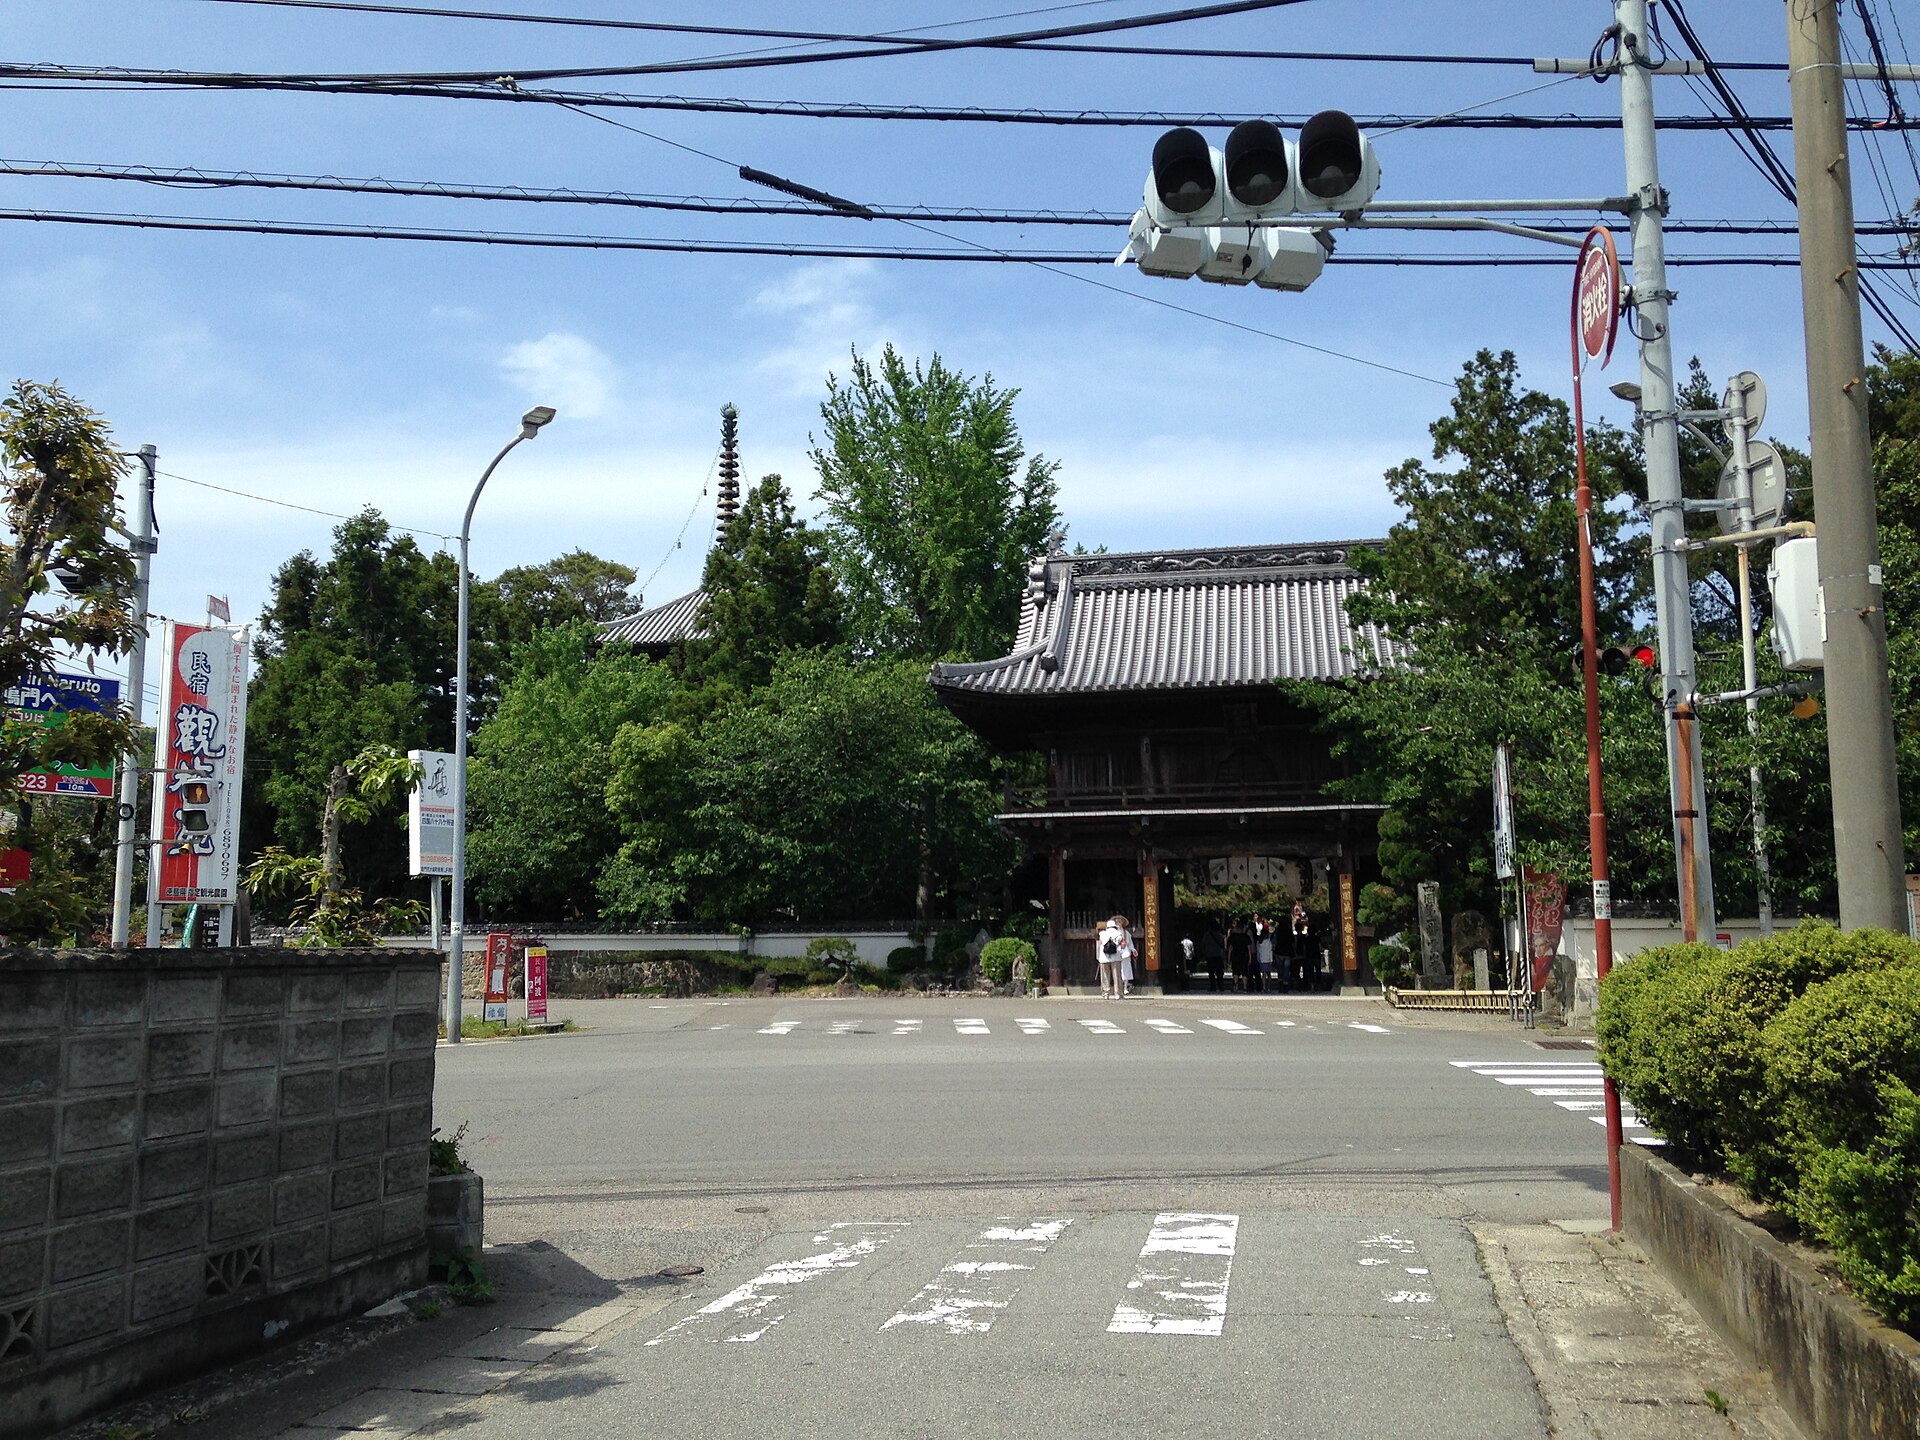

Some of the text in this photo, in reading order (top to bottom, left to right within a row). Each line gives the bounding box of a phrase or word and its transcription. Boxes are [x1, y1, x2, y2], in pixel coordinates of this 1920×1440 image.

[1583, 271, 1608, 335] 消火栓
[188, 651, 210, 695] 民宿
